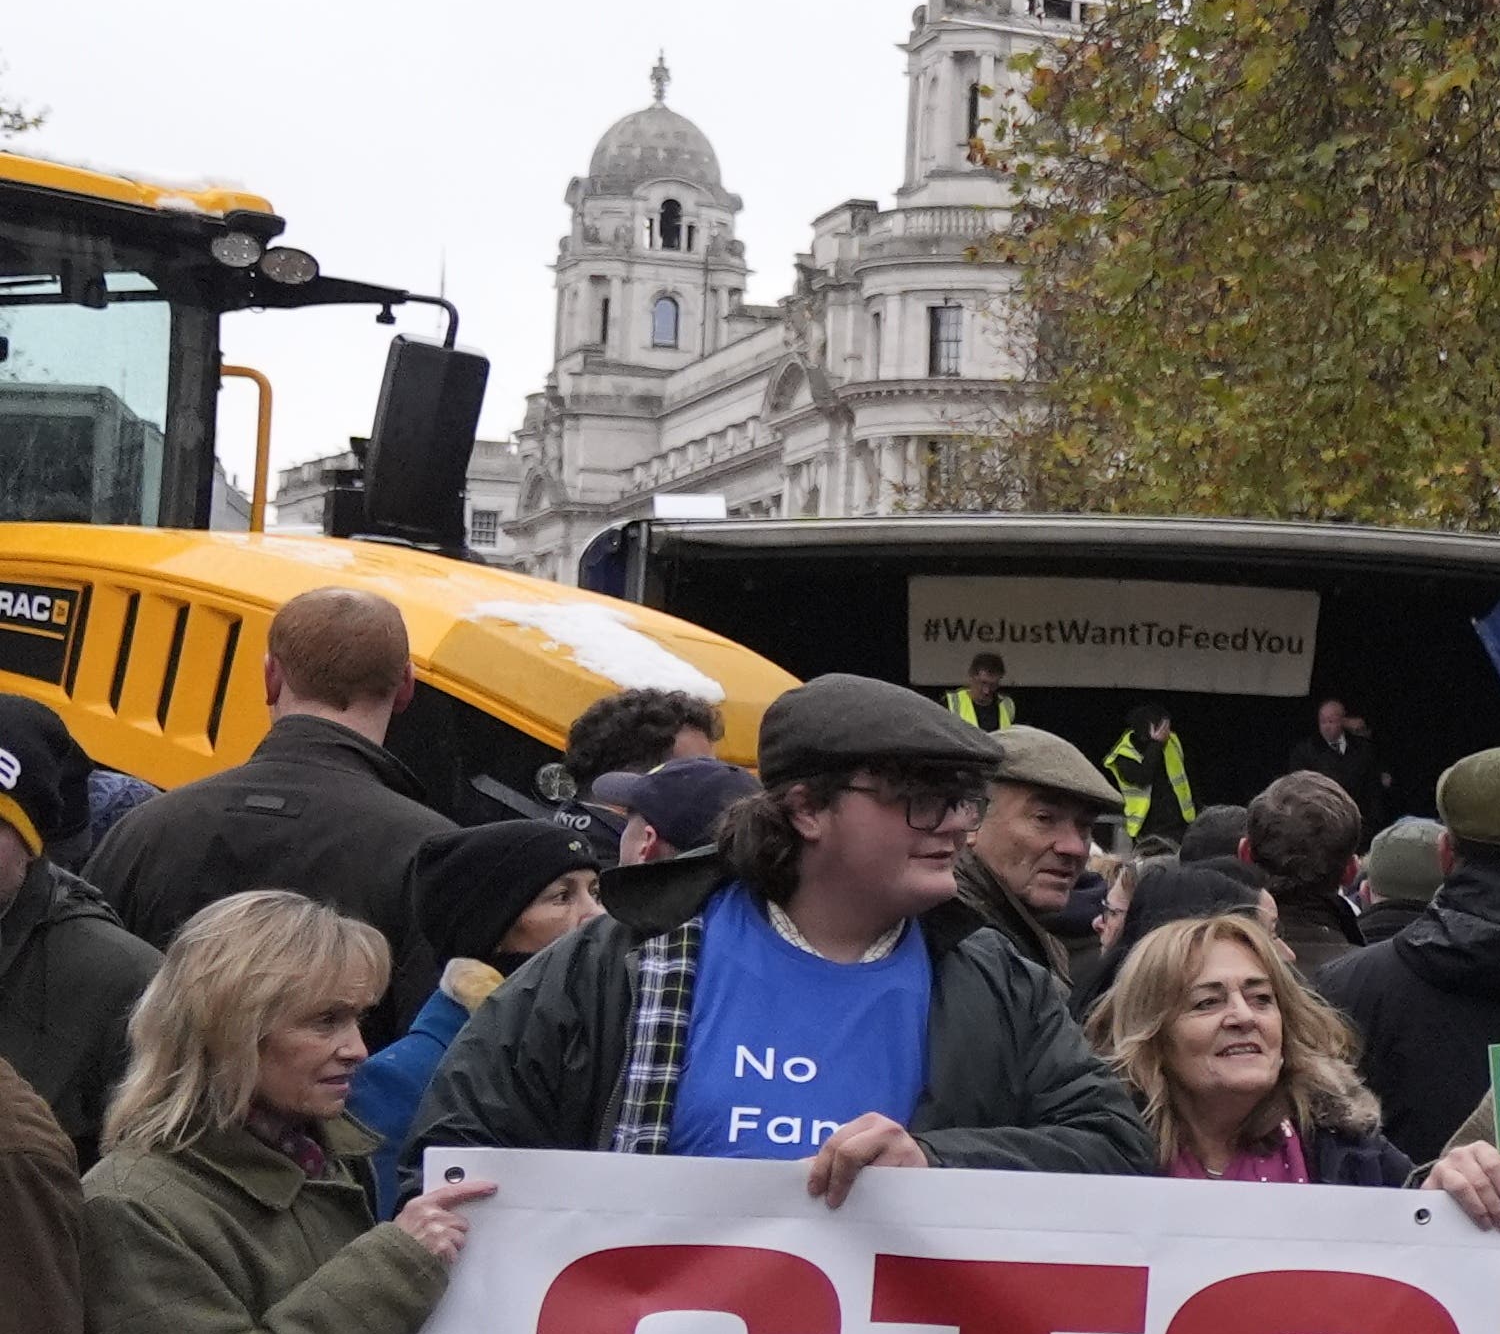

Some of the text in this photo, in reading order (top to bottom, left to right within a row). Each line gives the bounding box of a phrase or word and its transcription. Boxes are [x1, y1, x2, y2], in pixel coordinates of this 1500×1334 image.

[0, 590, 52, 622] RAC
[923, 617, 1304, 655] #WeJustWantToFeedYou
[734, 1044, 818, 1084] No
